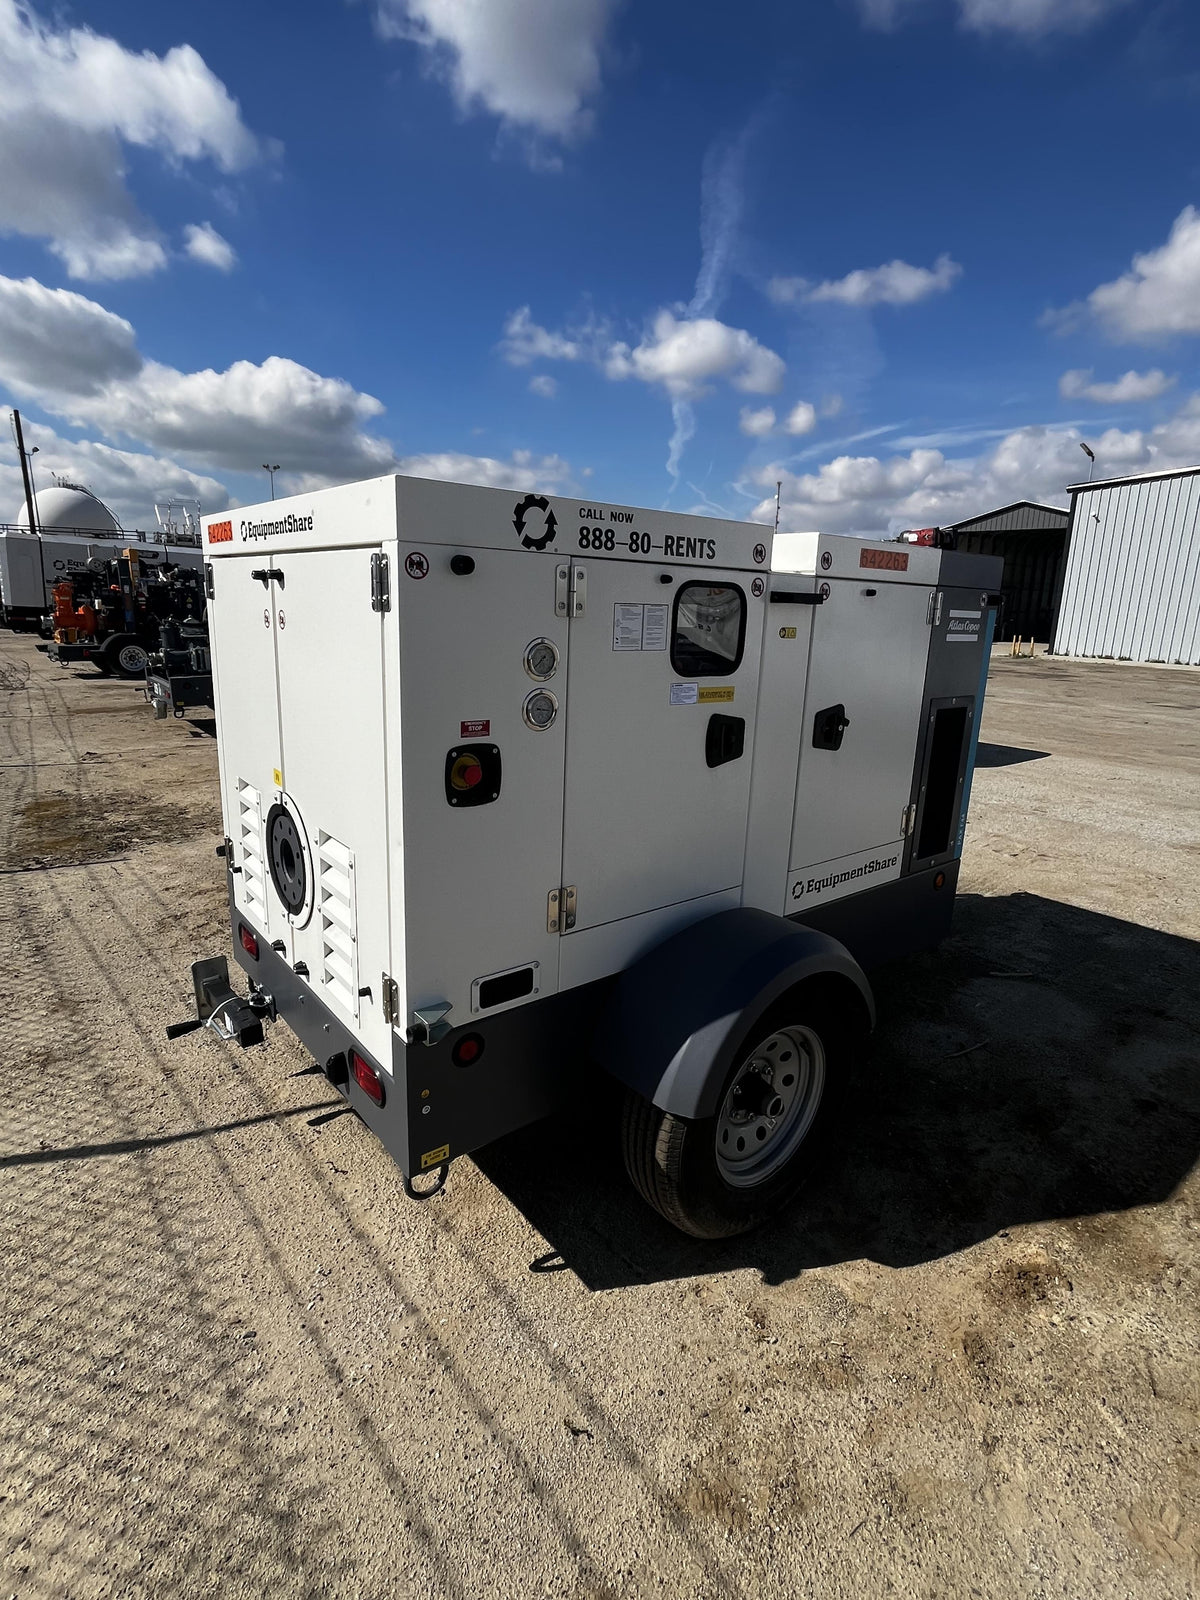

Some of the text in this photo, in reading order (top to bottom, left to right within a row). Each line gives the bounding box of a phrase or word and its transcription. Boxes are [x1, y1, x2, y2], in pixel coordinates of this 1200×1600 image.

[579, 507, 634, 523] CALL NOW
[248, 514, 313, 541] EquipmentShare
[578, 526, 716, 559] 888-80-RENTS
[861, 549, 908, 571] 642263
[948, 619, 980, 633] Atlas Copco
[806, 856, 897, 893] EquipmentShare
